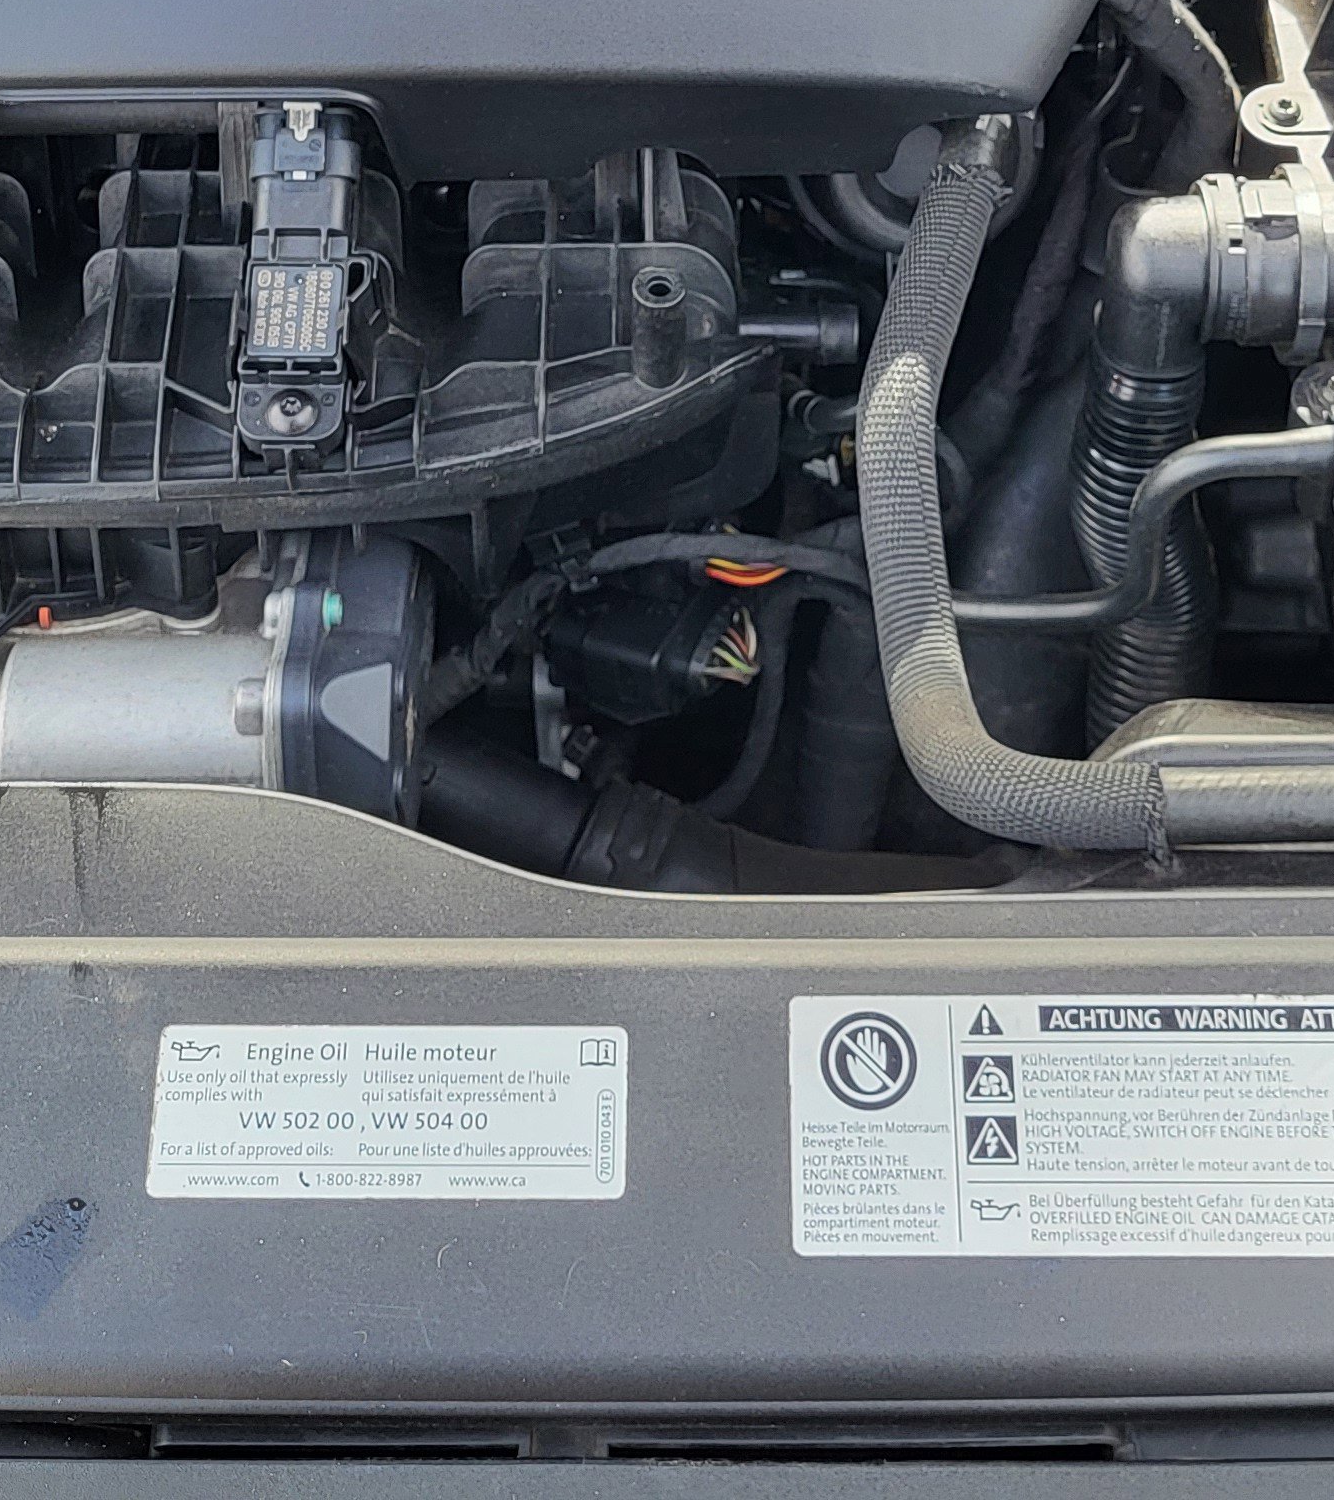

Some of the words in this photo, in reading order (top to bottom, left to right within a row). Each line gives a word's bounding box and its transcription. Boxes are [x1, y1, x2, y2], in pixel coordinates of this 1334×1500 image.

[1048, 1008, 1162, 1029] ACHTUNG
[1174, 1006, 1288, 1029] WARNING
[247, 1042, 314, 1066] Engine
[320, 1041, 347, 1061] Oil
[365, 1041, 417, 1061] Huile
[423, 1043, 497, 1061] moteur
[1020, 1051, 1130, 1067] Kühlerventilator
[1132, 1052, 1166, 1066] kann
[1169, 1052, 1228, 1069] jederzeit
[1231, 1052, 1295, 1066] anlaufen.
[167, 1069, 193, 1083] Use
[195, 1068, 227, 1088] only
[229, 1068, 246, 1083] oil
[250, 1069, 279, 1083] that
[282, 1068, 348, 1088] expressly
[363, 1069, 414, 1084] Utilisez
[418, 1070, 504, 1089] uniquement
[507, 1070, 525, 1084] de
[528, 1070, 570, 1084] l'huile
[1021, 1069, 1091, 1082] RADIATOR
[1093, 1069, 1121, 1082] FAN
[1124, 1069, 1156, 1082] MAY
[1158, 1068, 1198, 1082] START
[1203, 1069, 1219, 1082] AT
[1223, 1070, 1251, 1082] ANY
[1256, 1069, 1293, 1083] TIME.
[164, 1086, 227, 1105] complies
[230, 1087, 262, 1101] with
[361, 1088, 383, 1106] qui
[387, 1087, 442, 1102] satisfait
[446, 1086, 545, 1106] expressément
[548, 1088, 556, 1102] à
[1022, 1085, 1038, 1099] Le
[1039, 1084, 1115, 1098] ventilateur
[1117, 1084, 1135, 1098] de
[1137, 1085, 1200, 1098] radiateur
[1203, 1086, 1235, 1102] peut
[1237, 1088, 1253, 1099] se
[1255, 1085, 1329, 1100] déclencher
[239, 1111, 276, 1129] VW
[282, 1111, 319, 1129] 502
[326, 1111, 354, 1129] 00
[371, 1111, 408, 1129] VW
[414, 1112, 454, 1130] 504
[456, 1112, 487, 1130] 00
[1023, 1107, 1131, 1125] Hochspannung,
[1131, 1111, 1154, 1122] vor
[1157, 1107, 1220, 1122] Berühren
[1222, 1107, 1245, 1122] der
[1248, 1107, 1331, 1126] Zündanlage
[801, 1121, 838, 1134] Heisse
[839, 1120, 866, 1133] Teile
[1024, 1124, 1062, 1138] HIGH
[1064, 1123, 1131, 1140] VOLTAGE,
[1132, 1124, 1187, 1139] SWITCH
[1190, 1124, 1216, 1138] OFF
[1219, 1124, 1274, 1138] ENGINE
[1276, 1124, 1329, 1139] BEFORE
[159, 1142, 182, 1155] For
[184, 1145, 193, 1155] a
[196, 1141, 217, 1156] list
[219, 1141, 234, 1156] of
[237, 1140, 302, 1160] approved
[305, 1141, 333, 1156] oils:
[358, 1142, 390, 1156] Pour
[392, 1145, 419, 1157] une
[422, 1141, 450, 1157] liste
[453, 1141, 506, 1157] d'huiles
[508, 1142, 592, 1161] approuvées:
[801, 1135, 855, 1151] Bewegte
[600, 1156, 611, 1177] 701
[802, 1154, 827, 1166] HOT
[830, 1154, 867, 1166] PARTS
[869, 1154, 883, 1166] IN
[885, 1154, 910, 1166] THE
[1026, 1157, 1070, 1172] Haute
[1074, 1156, 1130, 1173] tension,
[1132, 1157, 1179, 1172] arrêter
[1182, 1156, 1195, 1171] le
[1197, 1157, 1248, 1172] moteur
[1252, 1158, 1292, 1172] avant
[1293, 1157, 1311, 1172] de
[187, 1175, 279, 1186] www.vw.com
[316, 1172, 422, 1186] 1-800-822-8987
[448, 1176, 526, 1187] www.vw.ca
[802, 1168, 849, 1180] ENGINE
[802, 1183, 855, 1196] MOVING
[803, 1201, 840, 1216] Pièces
[842, 1201, 900, 1215] brûlantes
[902, 1202, 932, 1214] dans
[934, 1201, 945, 1215] le
[1053, 1192, 1138, 1212] Überfüllung
[1140, 1193, 1194, 1208] besteht
[1196, 1193, 1243, 1208] Gefahr
[1250, 1193, 1270, 1208] für
[1273, 1194, 1301, 1208] den
[802, 1215, 890, 1232] compartiment
[1029, 1210, 1112, 1225] OVERFILLED
[1114, 1210, 1170, 1225] ENGINE
[1171, 1211, 1196, 1224] OIL
[1201, 1211, 1232, 1225] CAN
[1235, 1211, 1299, 1225] DAMAGE
[803, 1229, 841, 1243] Pièces
[843, 1233, 858, 1242] en
[1030, 1226, 1117, 1246] Remplissage
[1119, 1227, 1175, 1242] excessif
[1178, 1227, 1225, 1242] d'huile
[1226, 1226, 1302, 1246] dangereux
